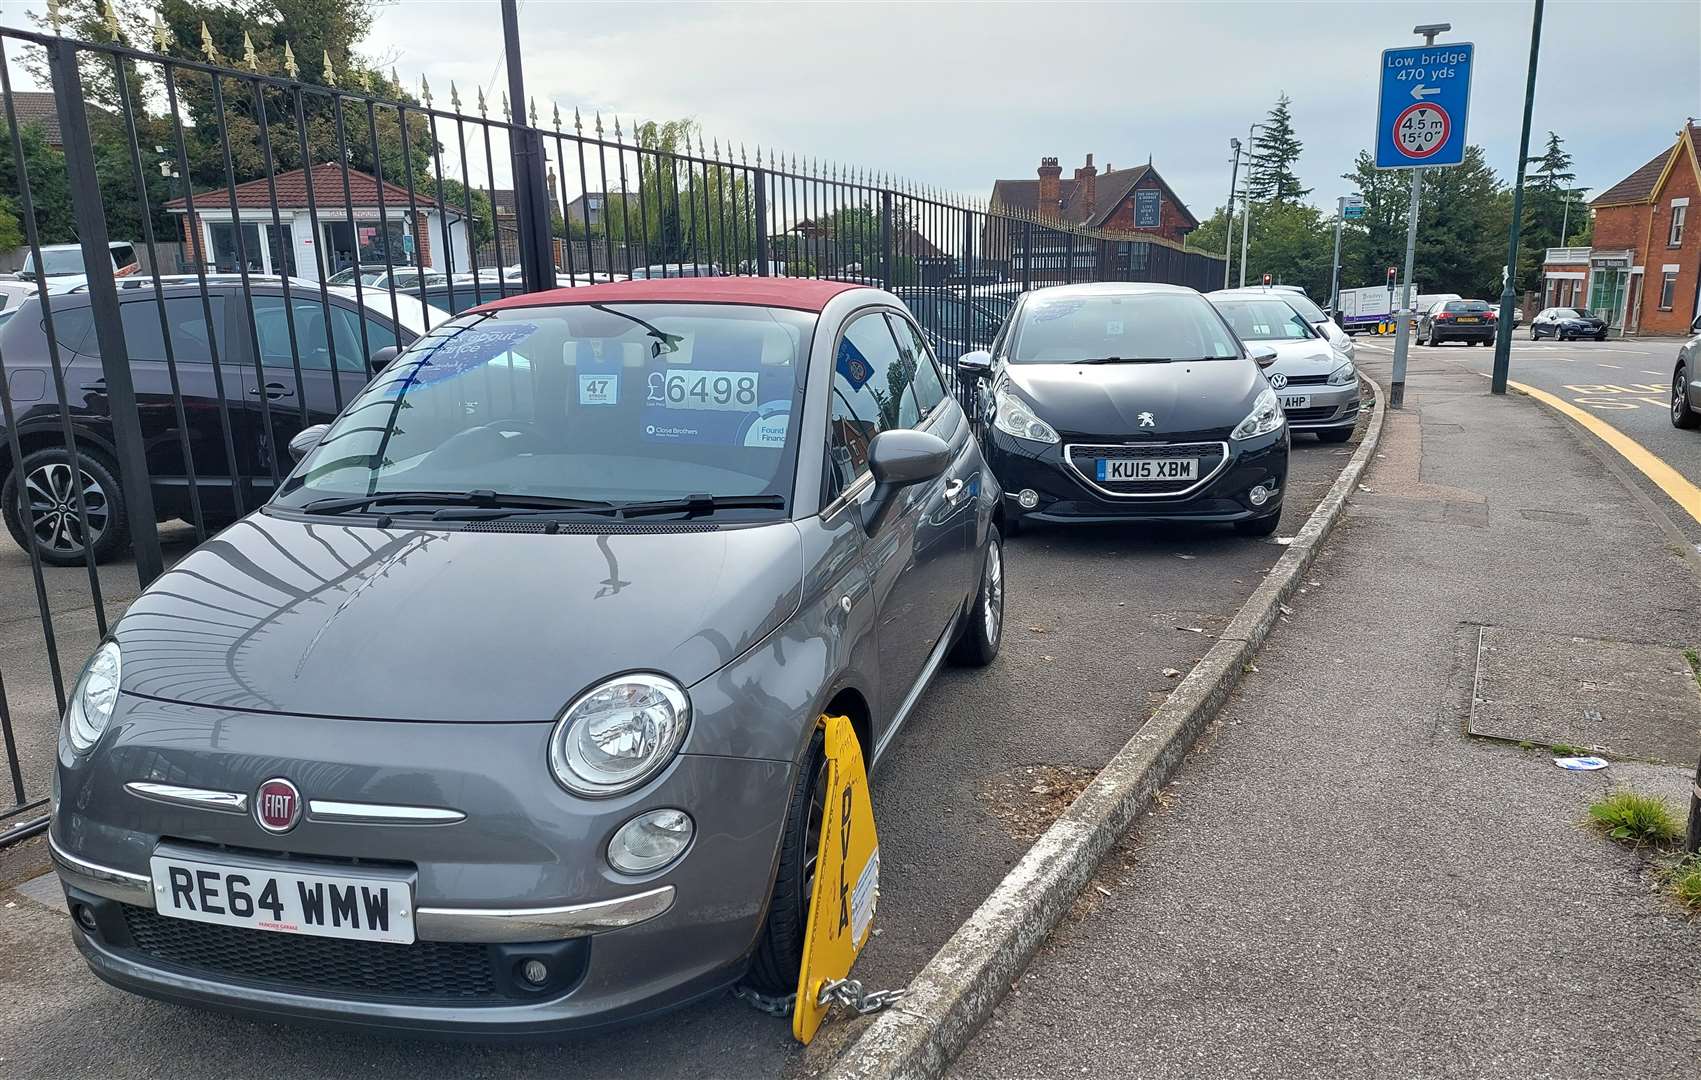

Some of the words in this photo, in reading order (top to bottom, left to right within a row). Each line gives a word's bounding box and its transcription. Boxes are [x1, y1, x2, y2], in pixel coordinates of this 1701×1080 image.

[1388, 56, 1415, 68] Low
[1421, 52, 1467, 65] bridge
[1397, 68, 1425, 81] 470
[1431, 67, 1456, 81] yds
[1402, 118, 1426, 130] 4.5
[1430, 120, 1442, 129] m
[586, 380, 609, 395] 47
[647, 371, 756, 405] £6498
[1284, 396, 1306, 408] AHP
[673, 427, 698, 436] Brothers
[761, 426, 784, 434] Found
[761, 434, 785, 442] Financ
[1111, 461, 1151, 478] KU15
[1157, 460, 1191, 477] XBM
[264, 793, 292, 819] FIAT
[838, 784, 853, 939] DVLA
[168, 866, 285, 921] RE64
[297, 880, 390, 932] WMW
